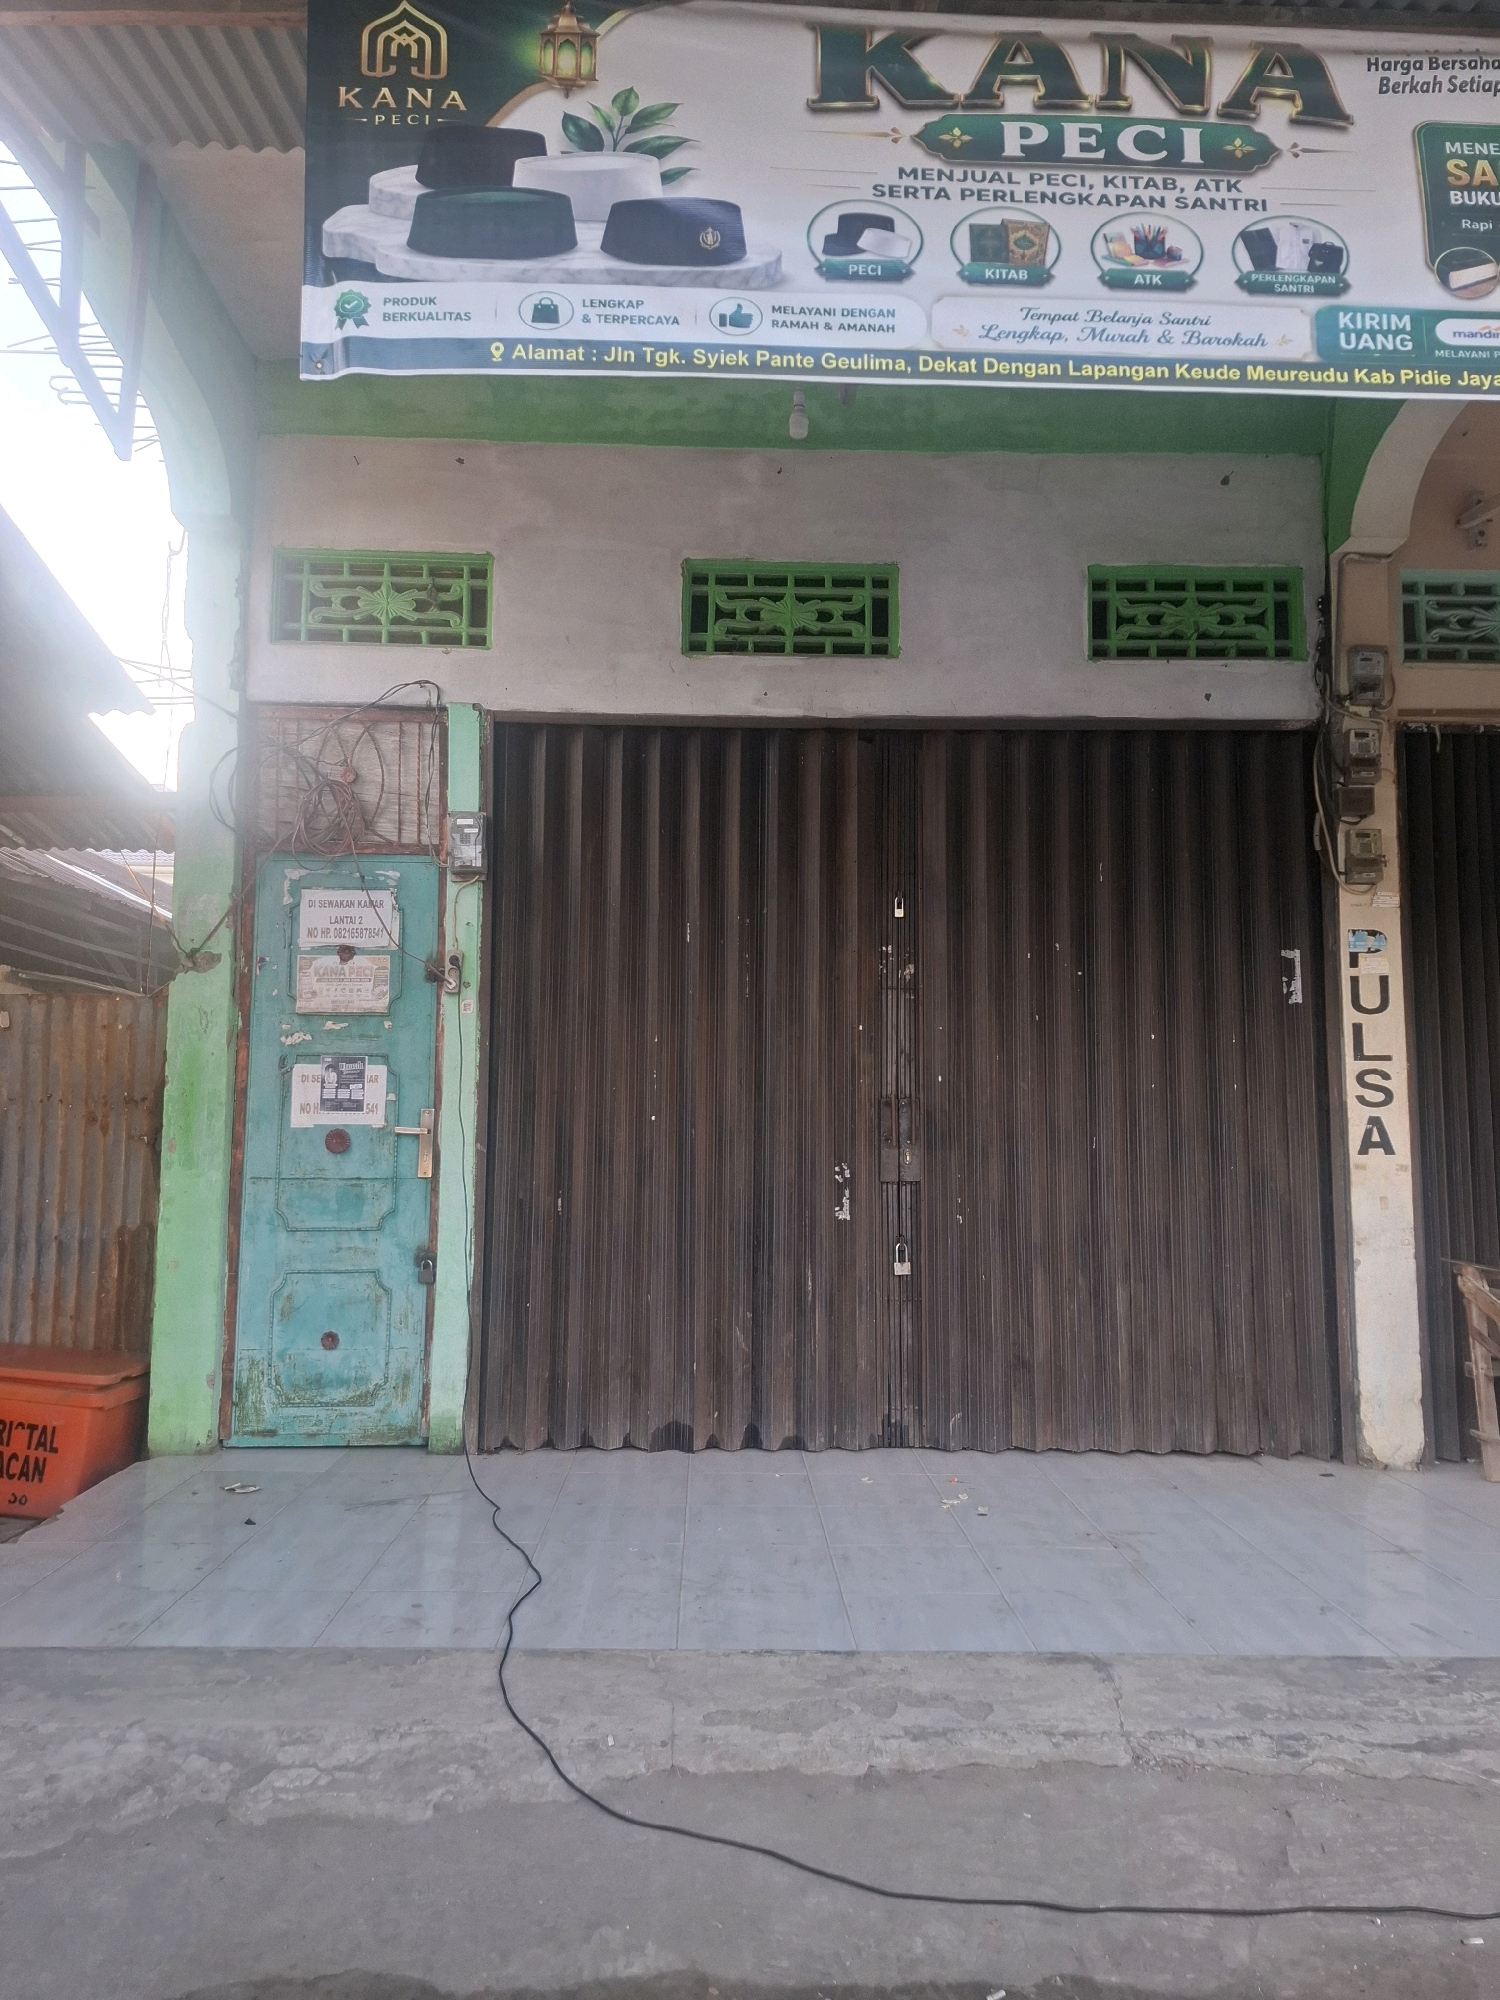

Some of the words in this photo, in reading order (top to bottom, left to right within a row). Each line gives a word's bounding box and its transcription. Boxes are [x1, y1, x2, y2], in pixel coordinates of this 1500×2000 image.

[1367, 57, 1423, 75] Harga
[1428, 55, 1500, 70] Bersaha
[807, 25, 1354, 126] KANA
[1379, 75, 1443, 94] Berkah
[338, 86, 467, 111] KANA
[375, 114, 429, 125] PECI
[1000, 122, 1204, 164] PECI
[1445, 142, 1500, 155] MENE
[1446, 158, 1500, 187] SA
[898, 167, 1021, 186] MENJUAL
[1029, 172, 1094, 190] PECI,
[1103, 175, 1185, 193] KITAB,
[1194, 178, 1243, 193] ATK
[872, 183, 951, 201] SERTA
[960, 187, 1166, 208] PERLENGKAPAN
[1175, 197, 1267, 212] SANTRI
[1450, 190, 1500, 206] BUKU
[1462, 219, 1493, 232] Rapi
[849, 264, 881, 276] PECI
[985, 268, 1028, 281] KITAB
[1134, 274, 1162, 286] ATK
[1251, 274, 1336, 284] PERLENGKAPAN
[1274, 284, 1315, 293] SANTRI
[383, 296, 437, 307] PRODUK
[582, 299, 645, 310] LENGKAP
[382, 311, 471, 323] BERKUALITAS
[771, 305, 837, 317] MELAYANI
[841, 308, 896, 319] DENGAN
[1020, 307, 1079, 325] Tempat
[1085, 309, 1153, 328] Belanja
[1159, 312, 1212, 326] Santri
[582, 314, 592, 324] &
[595, 314, 680, 326] TERPERCAYA
[771, 320, 819, 331] RAMAH
[824, 322, 833, 331] &
[837, 322, 896, 333] AMANAH
[1338, 311, 1412, 331] KIRIM
[978, 323, 1069, 345] Lengkap,
[1077, 326, 1150, 344] Murah
[1157, 329, 1174, 344] &
[1182, 330, 1268, 348] Barokah
[1339, 332, 1413, 351] UANG
[1435, 350, 1490, 359] MELAYANI
[512, 343, 585, 362] Alamat
[604, 346, 635, 364] Jln
[642, 347, 686, 368] Tgk.
[693, 349, 748, 369] Syiek
[756, 350, 814, 369] Pante
[821, 352, 912, 375] Geulima,
[919, 356, 977, 374] Dekat
[983, 358, 1062, 378] Dengan
[1068, 360, 1169, 381] Lapangan
[1175, 364, 1241, 381] Keude
[1247, 365, 1348, 384] Meureudu
[1354, 368, 1395, 386] Kab
[1401, 369, 1451, 387] Pidie
[1458, 370, 1500, 390] Jaya
[308, 900, 316, 908] DI
[318, 900, 355, 909] SEWAKAN
[357, 900, 384, 909] KAMAR
[329, 916, 356, 925] LANTAI
[358, 916, 363, 925] 2
[307, 927, 318, 939] NO
[320, 927, 331, 939] HP.
[314, 965, 347, 977] KANA
[348, 965, 374, 977] PECI
[1347, 929, 1396, 1155] PULSA
[301, 1074, 308, 1083] DI
[299, 1103, 311, 1115] NO
